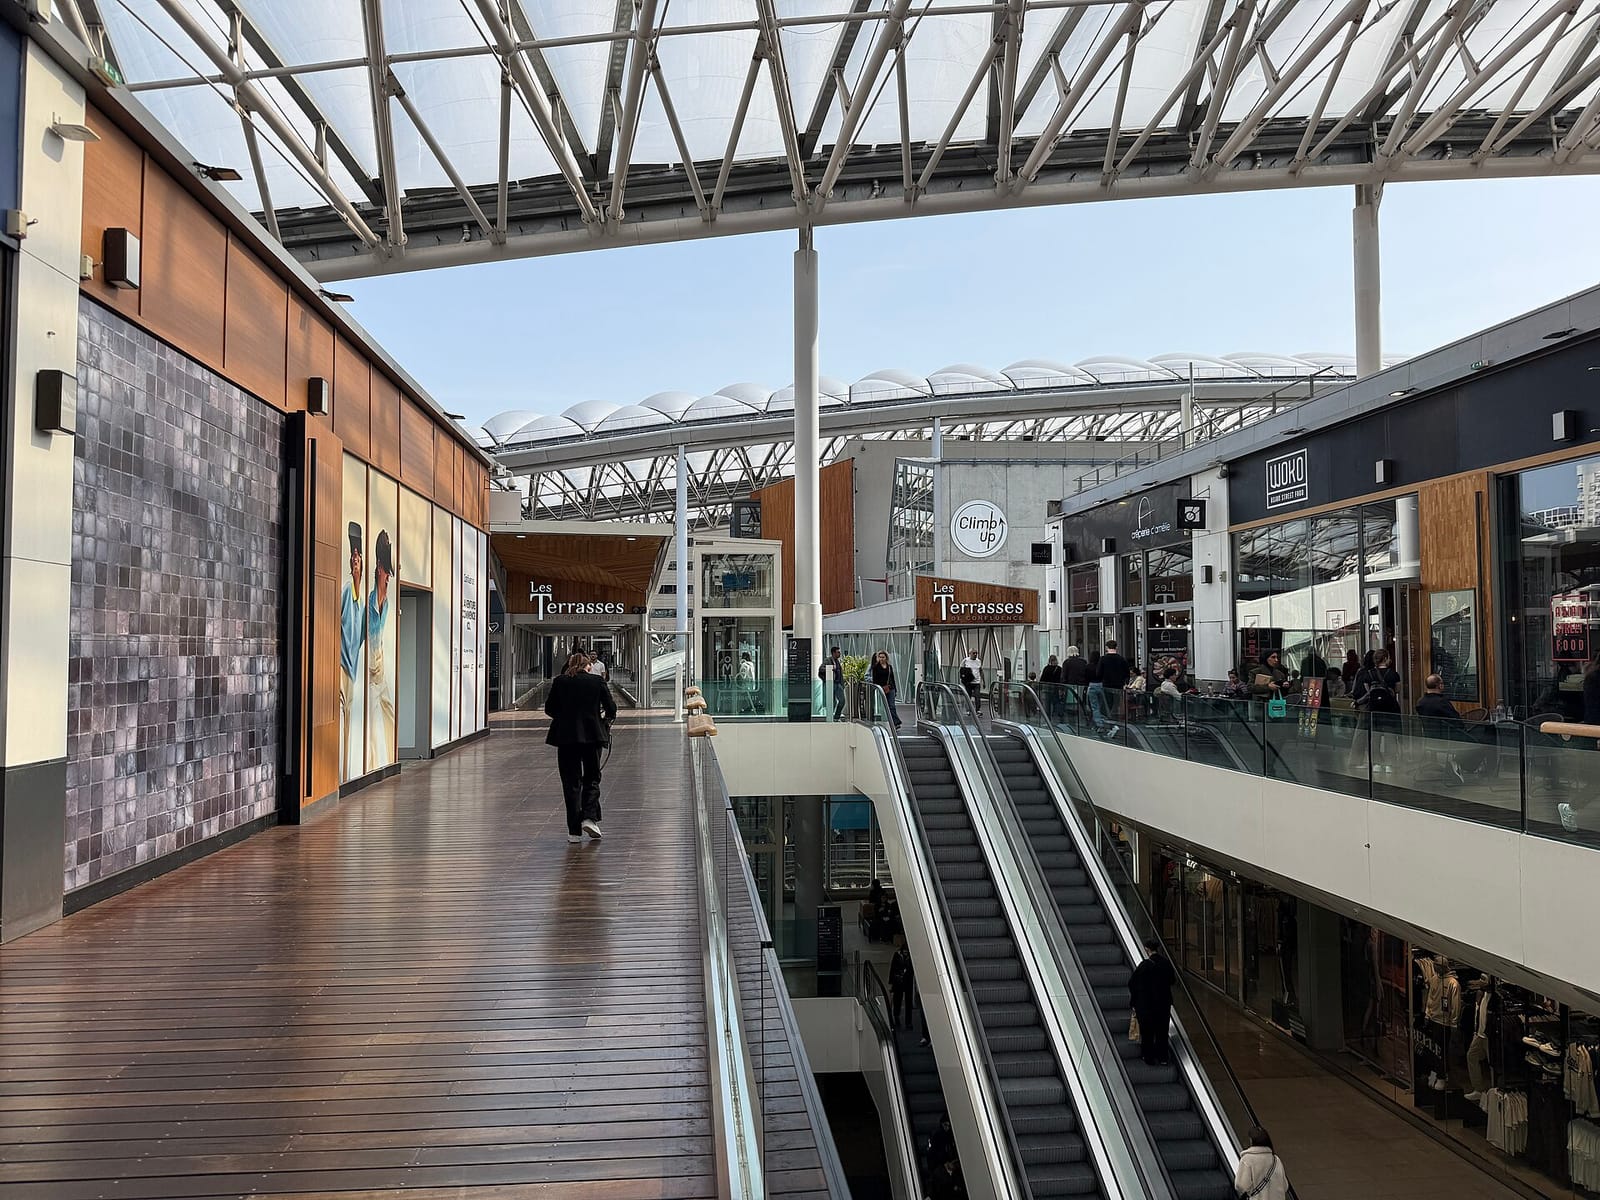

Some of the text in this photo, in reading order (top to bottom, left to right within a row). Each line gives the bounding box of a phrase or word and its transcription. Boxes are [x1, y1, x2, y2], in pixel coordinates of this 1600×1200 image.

[1270, 456, 1304, 489] WOKO
[959, 511, 998, 530] Climb
[529, 580, 553, 593] Les
[933, 581, 955, 593] Les
[529, 593, 625, 621] Terrasses
[933, 594, 1024, 621] Terrasses
[1555, 622, 1584, 634] STREET
[1556, 639, 1584, 651] FOOD
